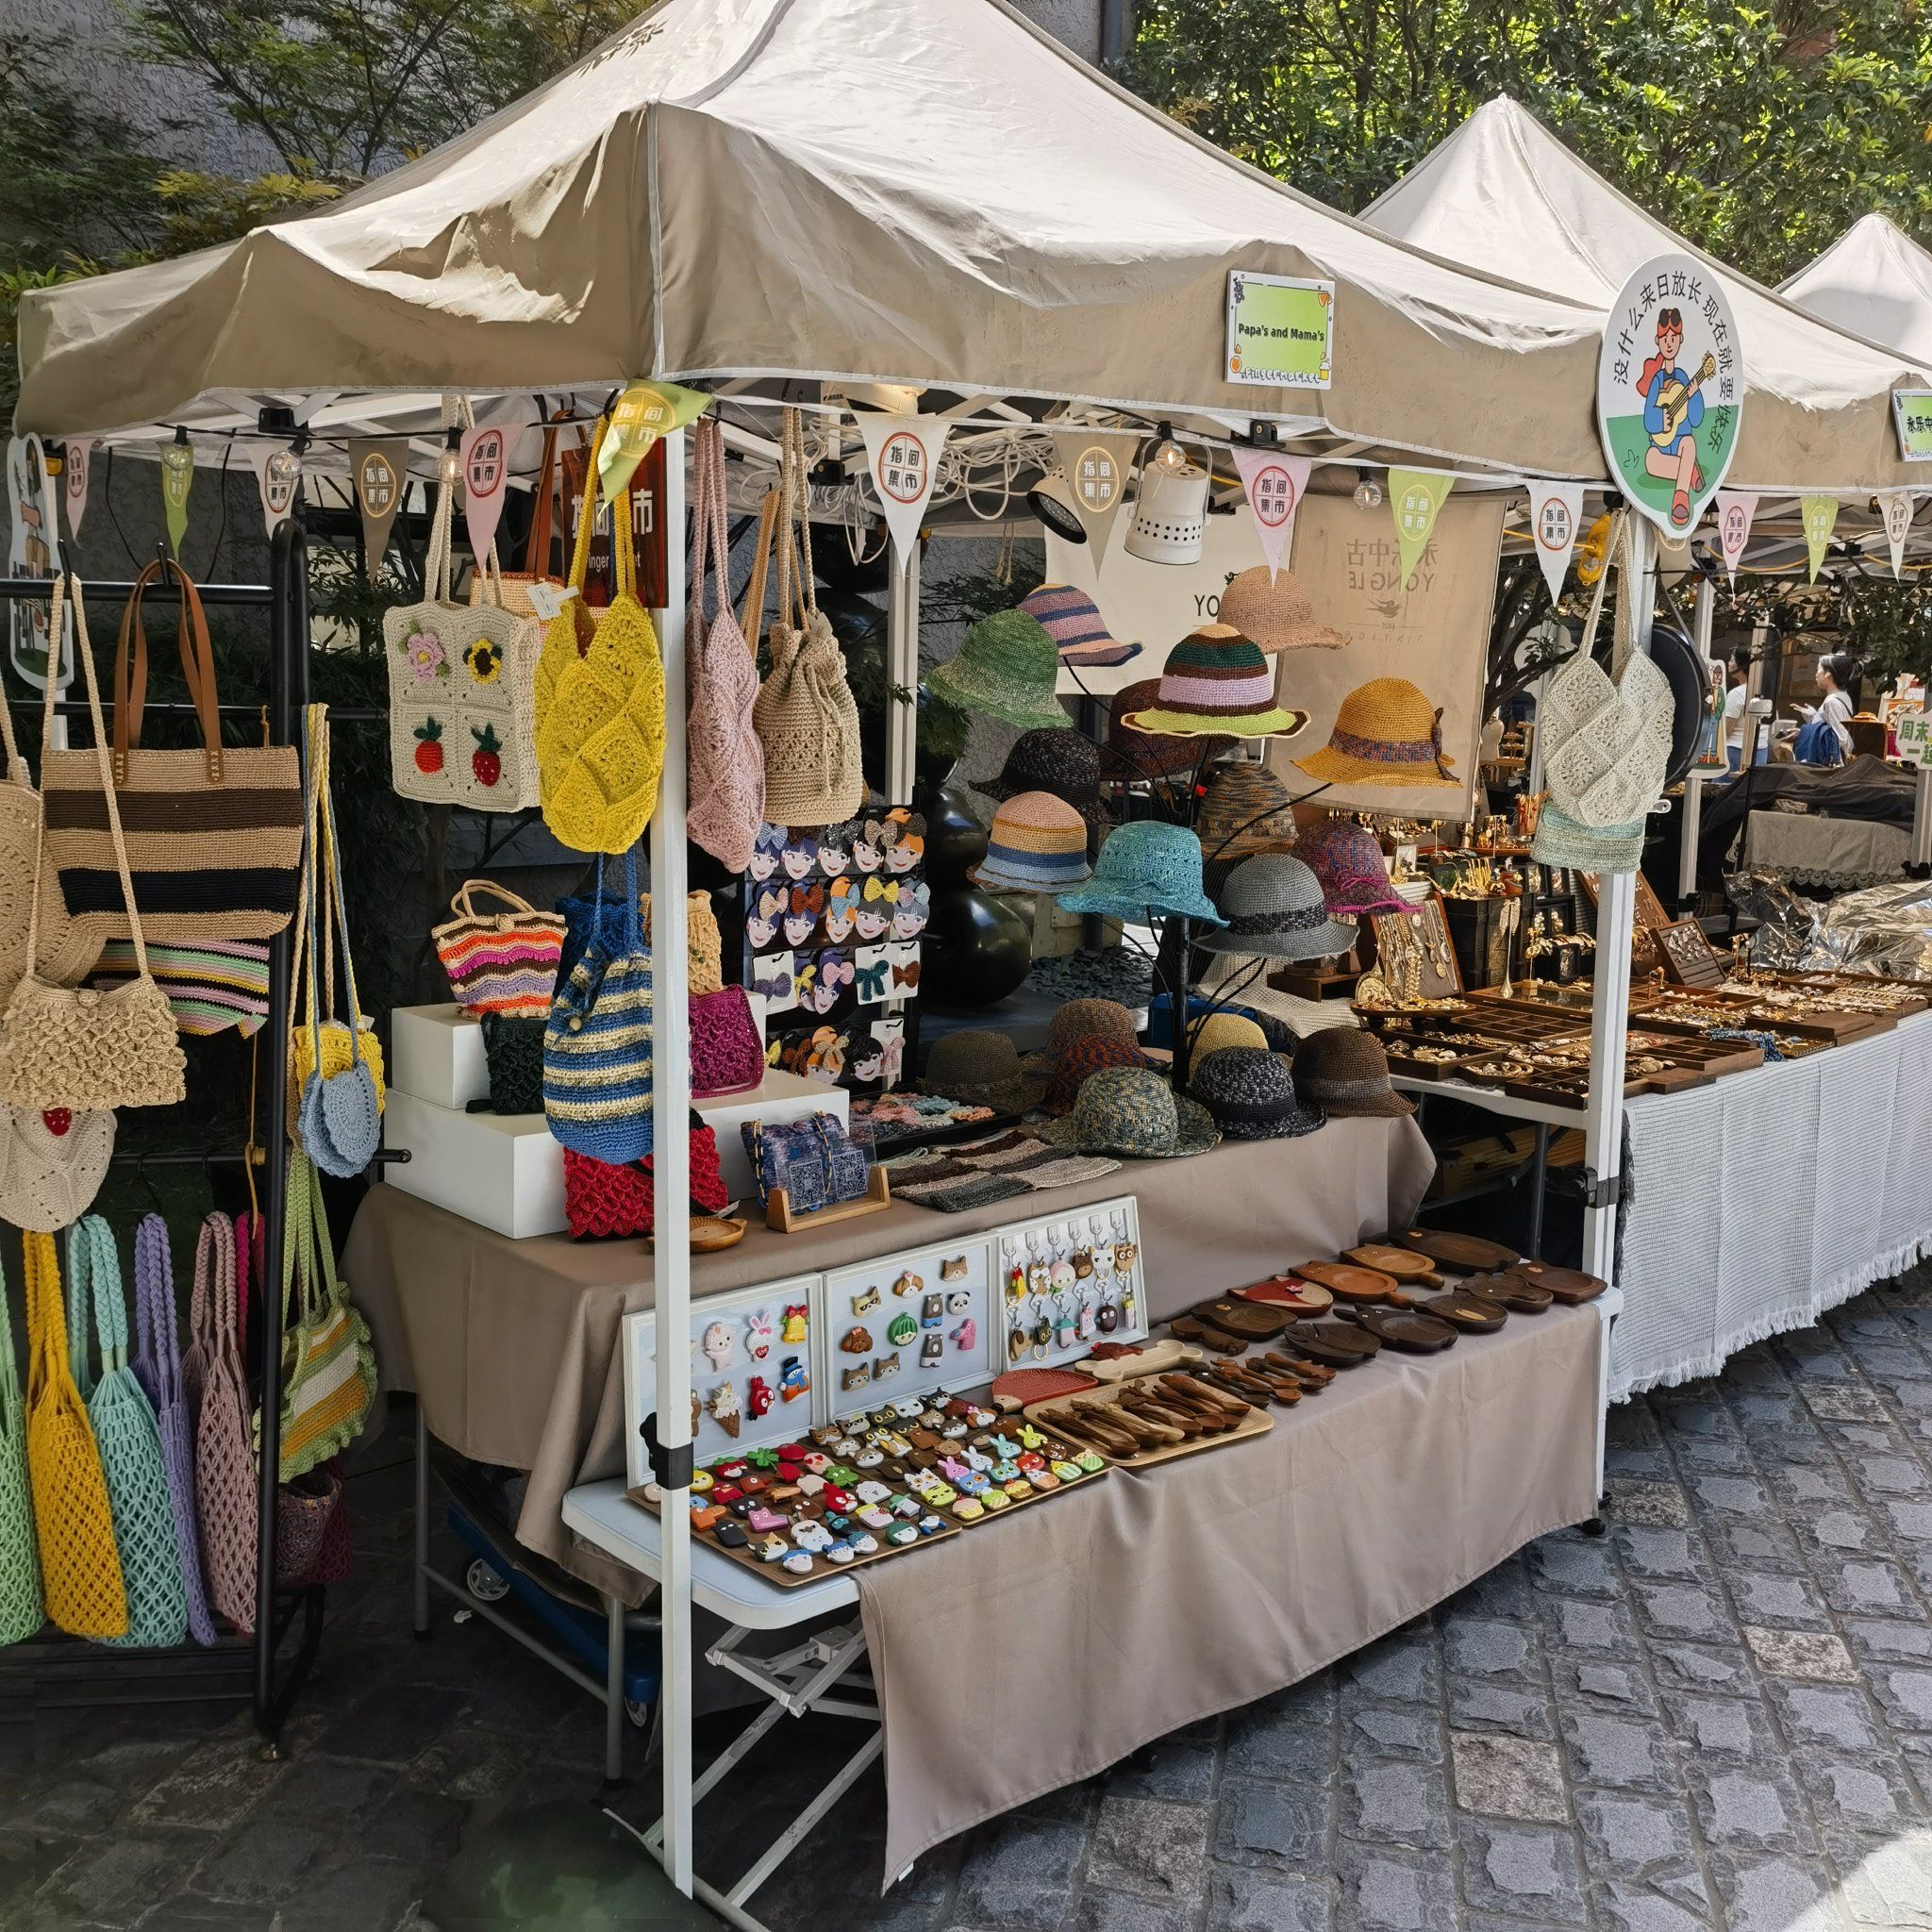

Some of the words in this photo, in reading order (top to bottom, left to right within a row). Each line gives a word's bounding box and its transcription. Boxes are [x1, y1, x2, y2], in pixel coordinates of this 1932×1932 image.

[1238, 324, 1269, 338] Papa's
[1271, 327, 1289, 339] and
[1291, 327, 1324, 341] Mama's
[1614, 271, 1702, 385] 没什么来日放长
[618, 402, 663, 422] 指间
[475, 441, 497, 459] 指间
[891, 445, 920, 467] 指间
[366, 467, 389, 482] 指间
[474, 465, 494, 483] 集市
[1083, 461, 1110, 476] 指间
[888, 469, 918, 489] 集市
[1260, 478, 1287, 493] 指间
[368, 489, 389, 503] 集市
[1084, 482, 1110, 497] 集市
[1260, 497, 1285, 513] 集市
[1405, 496, 1428, 511] 指间
[572, 489, 653, 539] 间市
[1404, 514, 1426, 530] 集市
[1545, 508, 1565, 522] 指间
[1545, 525, 1565, 540] 集市
[1899, 720, 1929, 741] 周末
